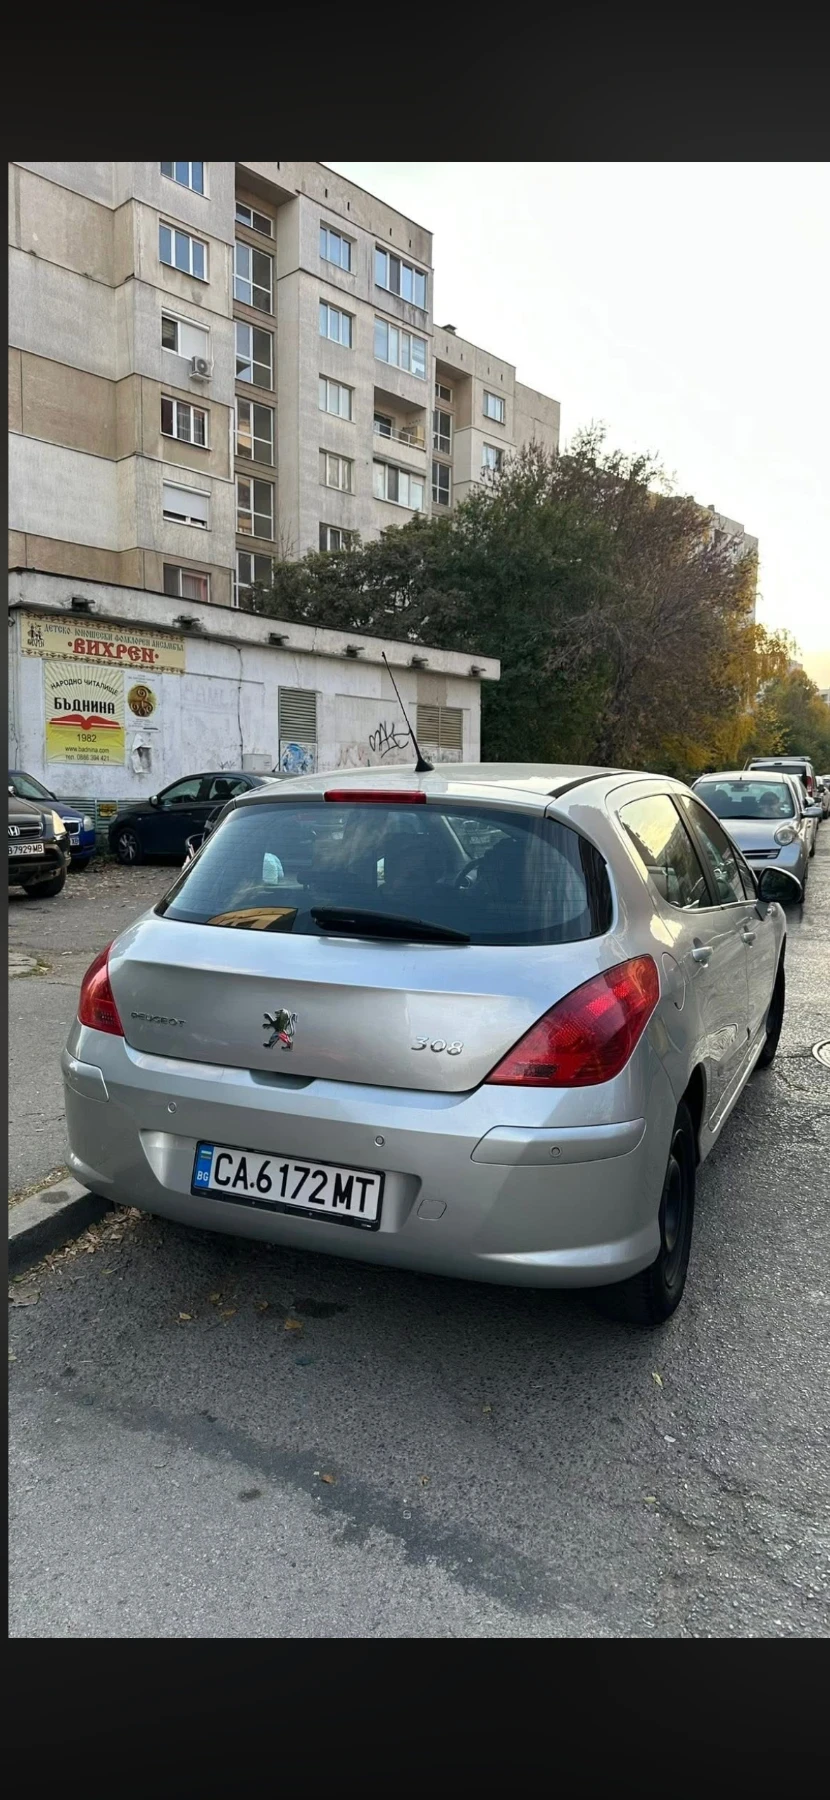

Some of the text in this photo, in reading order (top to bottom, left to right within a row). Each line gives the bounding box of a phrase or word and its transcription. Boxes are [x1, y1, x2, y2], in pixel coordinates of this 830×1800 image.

[50, 679, 118, 696] НАРОДНО ЧИТАЛИЩЕ
[54, 697, 115, 714] БЪДНИНА
[77, 733, 97, 743] 1982
[65, 746, 109, 754] www.badnina.com
[130, 1011, 186, 1028] PEUGEOT
[411, 1036, 464, 1056] 308
[196, 1170, 209, 1182] BG
